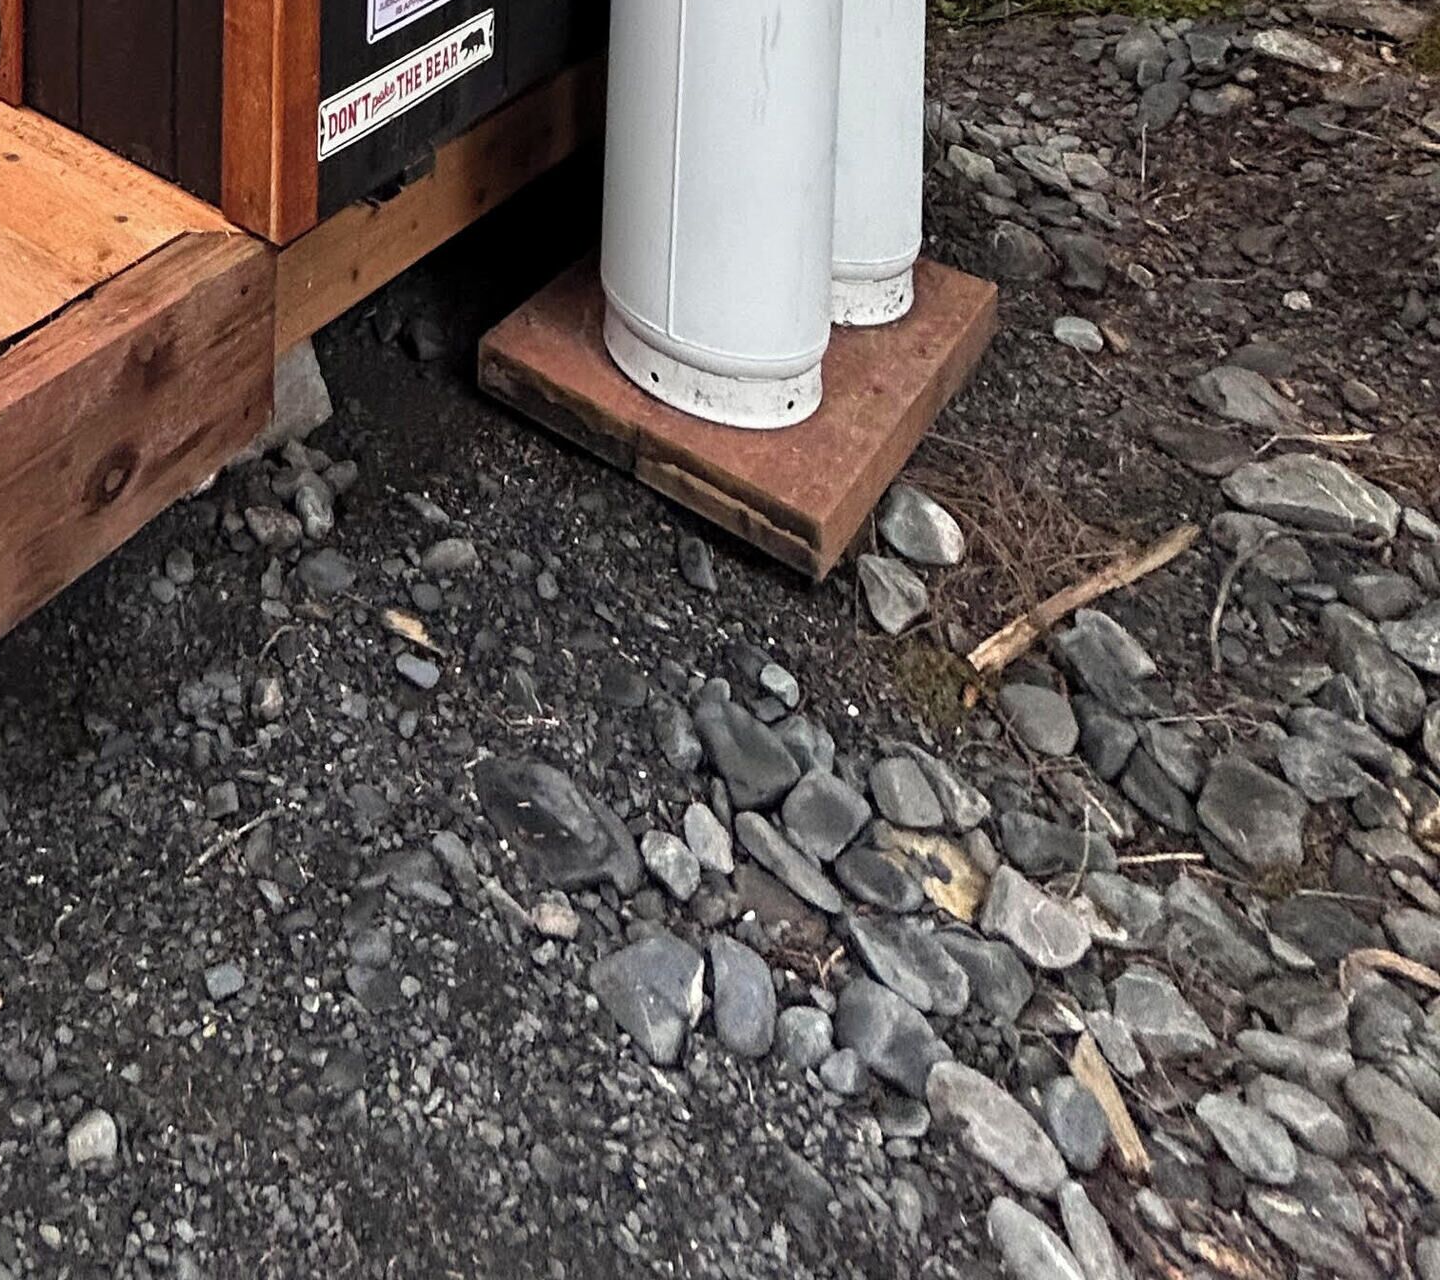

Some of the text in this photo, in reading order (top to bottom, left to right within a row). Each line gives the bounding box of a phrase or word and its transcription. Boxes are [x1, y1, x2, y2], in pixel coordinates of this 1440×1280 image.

[396, 5, 402, 15] IS
[328, 42, 458, 141] DON'T poke THE BEAR
